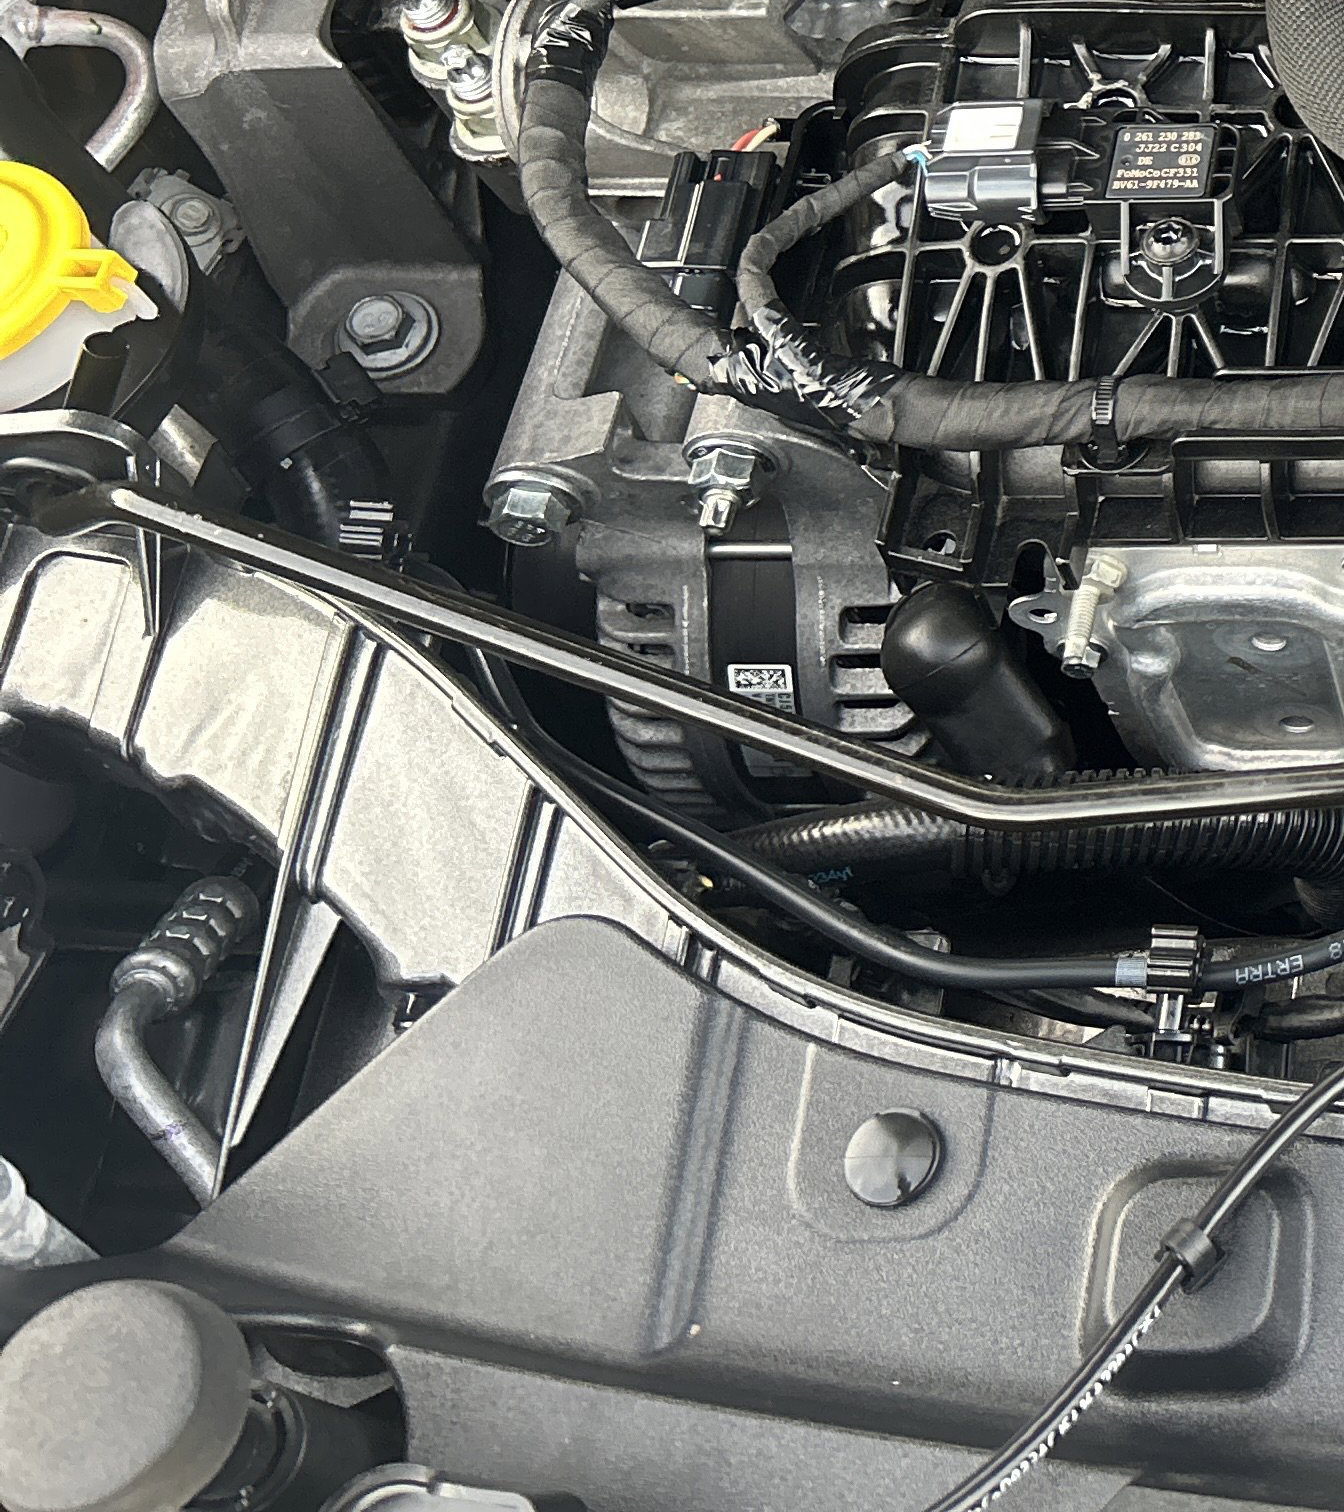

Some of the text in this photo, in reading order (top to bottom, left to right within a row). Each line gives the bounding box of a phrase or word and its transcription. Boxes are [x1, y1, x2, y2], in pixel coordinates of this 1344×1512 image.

[1123, 132, 1131, 141] 0
[1134, 132, 1154, 141] 261
[1158, 132, 1178, 141] 230
[1137, 156, 1153, 165] DE
[1235, 953, 1304, 985] ERTRA
